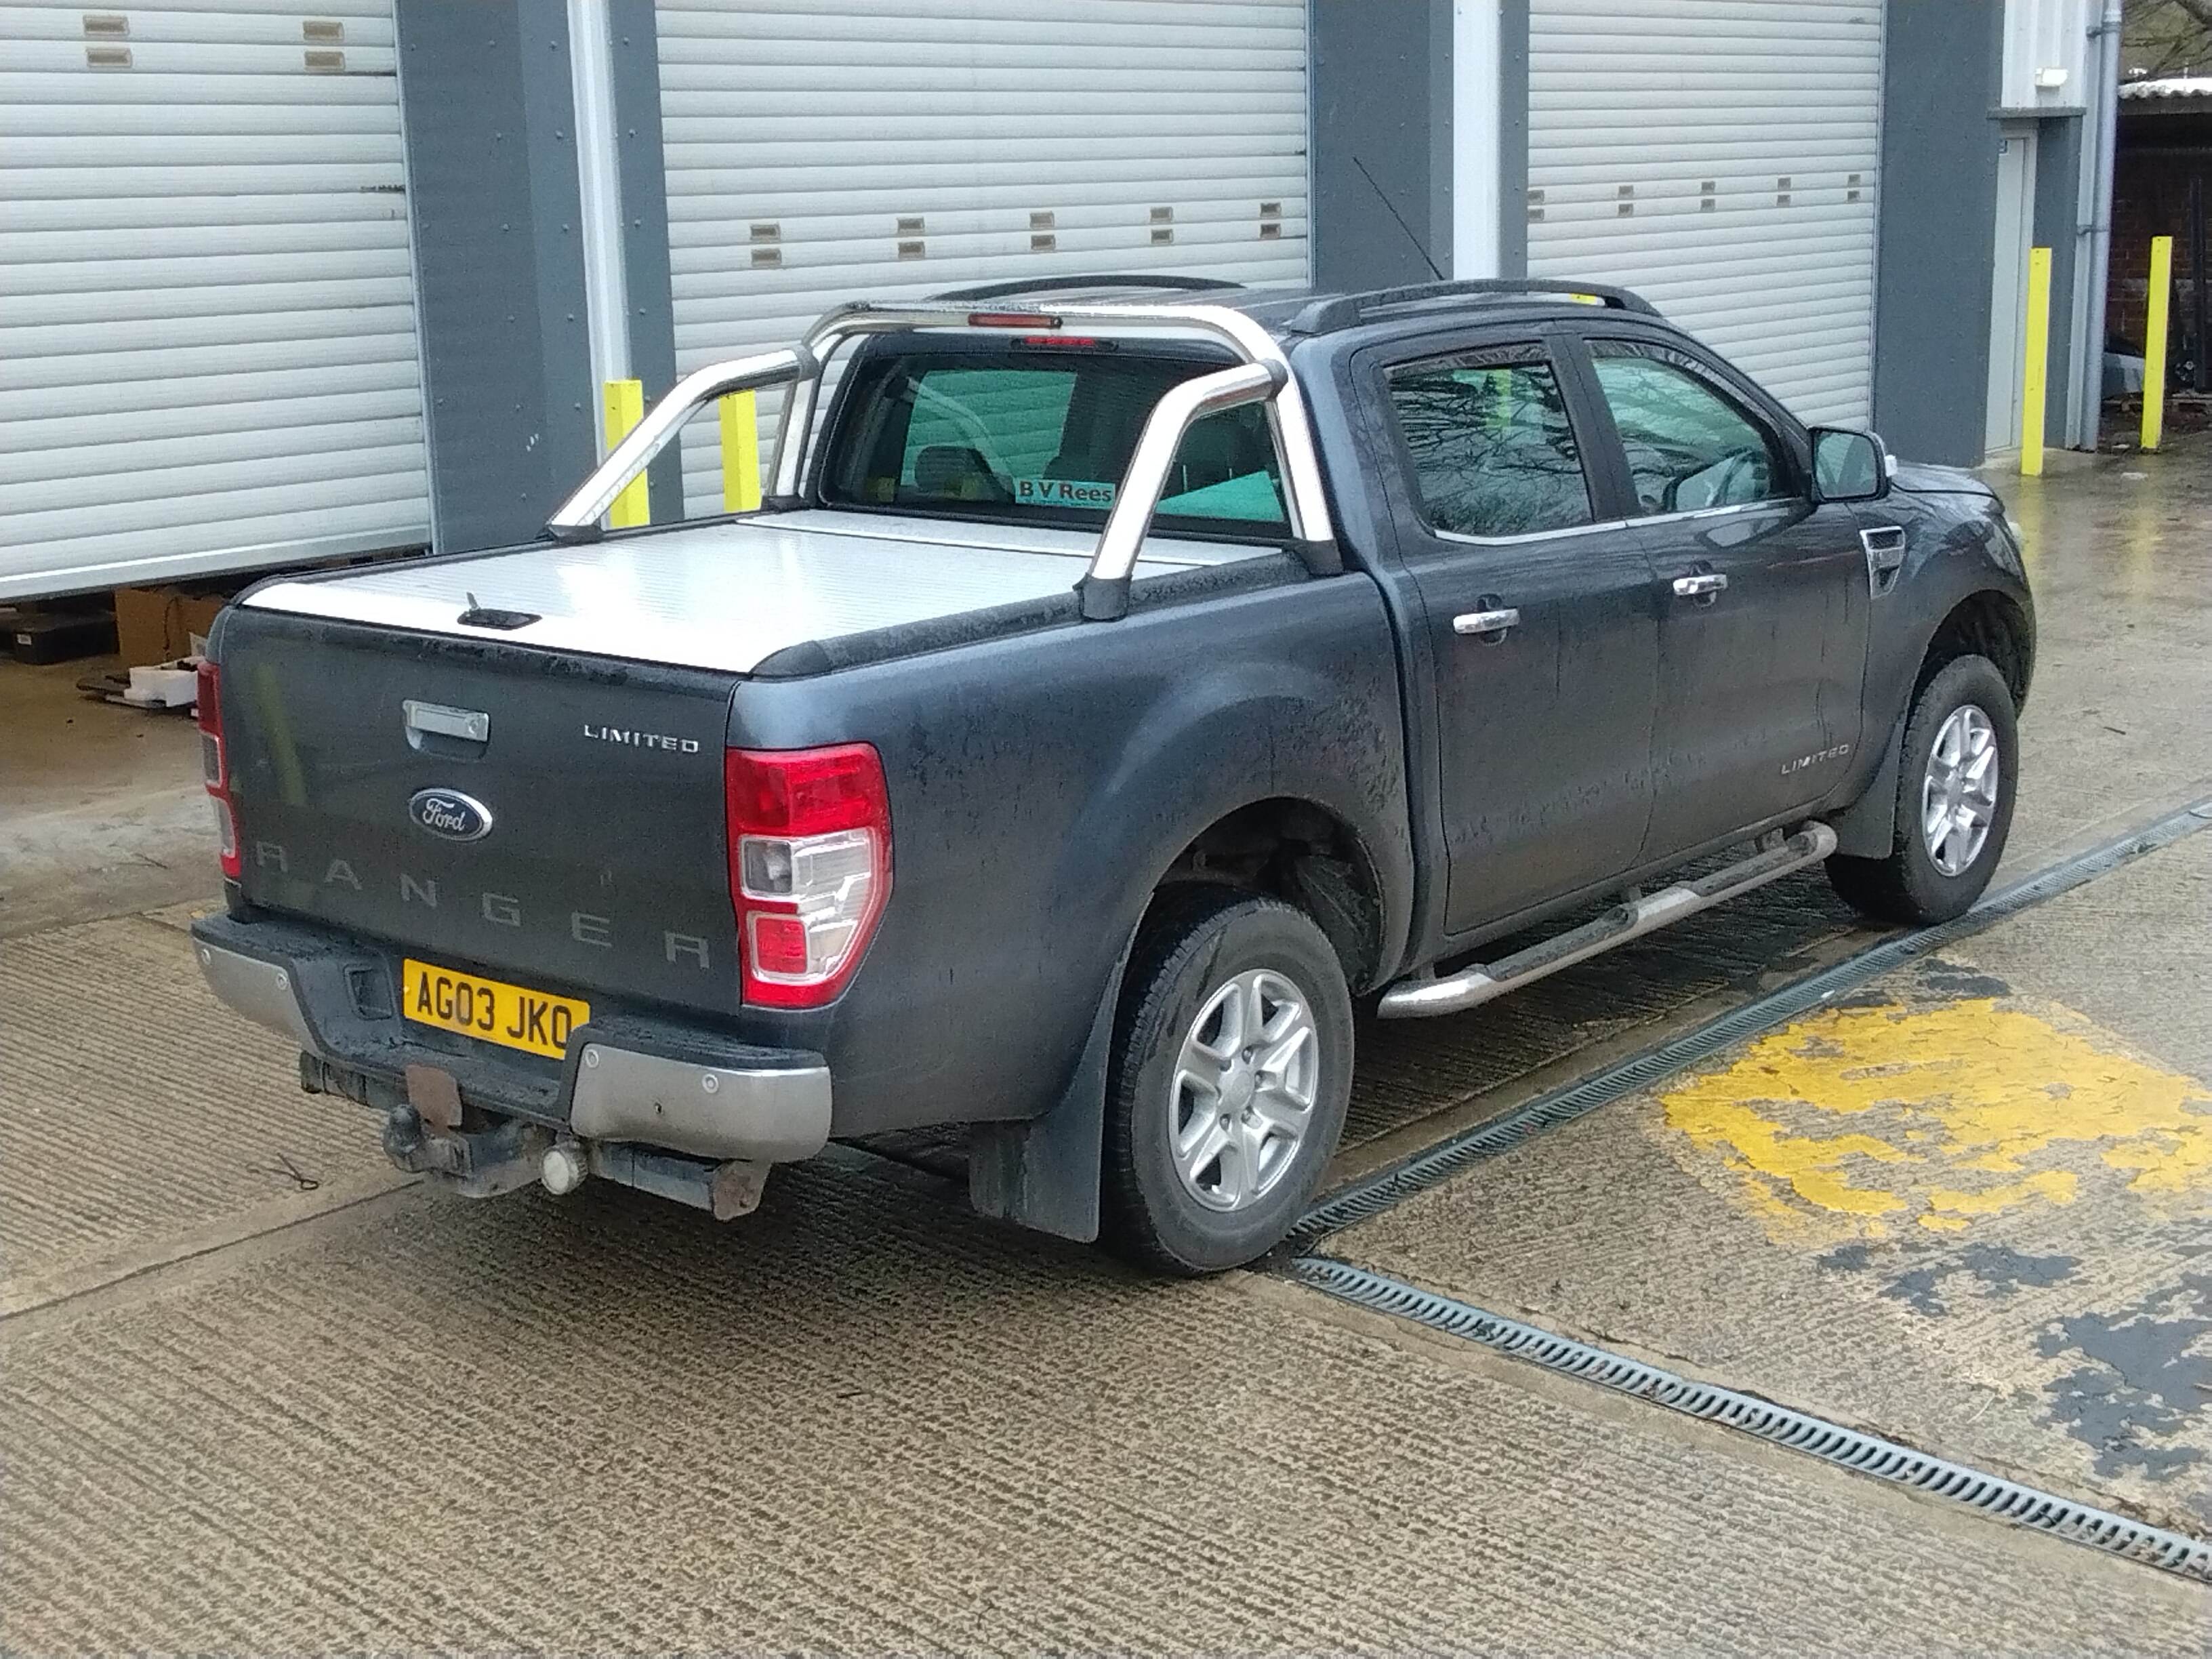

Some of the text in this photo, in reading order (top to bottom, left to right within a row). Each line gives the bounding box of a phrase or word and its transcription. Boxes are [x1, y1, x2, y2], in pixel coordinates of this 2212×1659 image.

[1019, 480, 1112, 502] B V Rees
[584, 724, 699, 753] LIMITED
[1781, 743, 1849, 775] LIMITED
[422, 798, 466, 832] Ford
[255, 840, 710, 970] RANGER
[416, 970, 495, 1031] AG03
